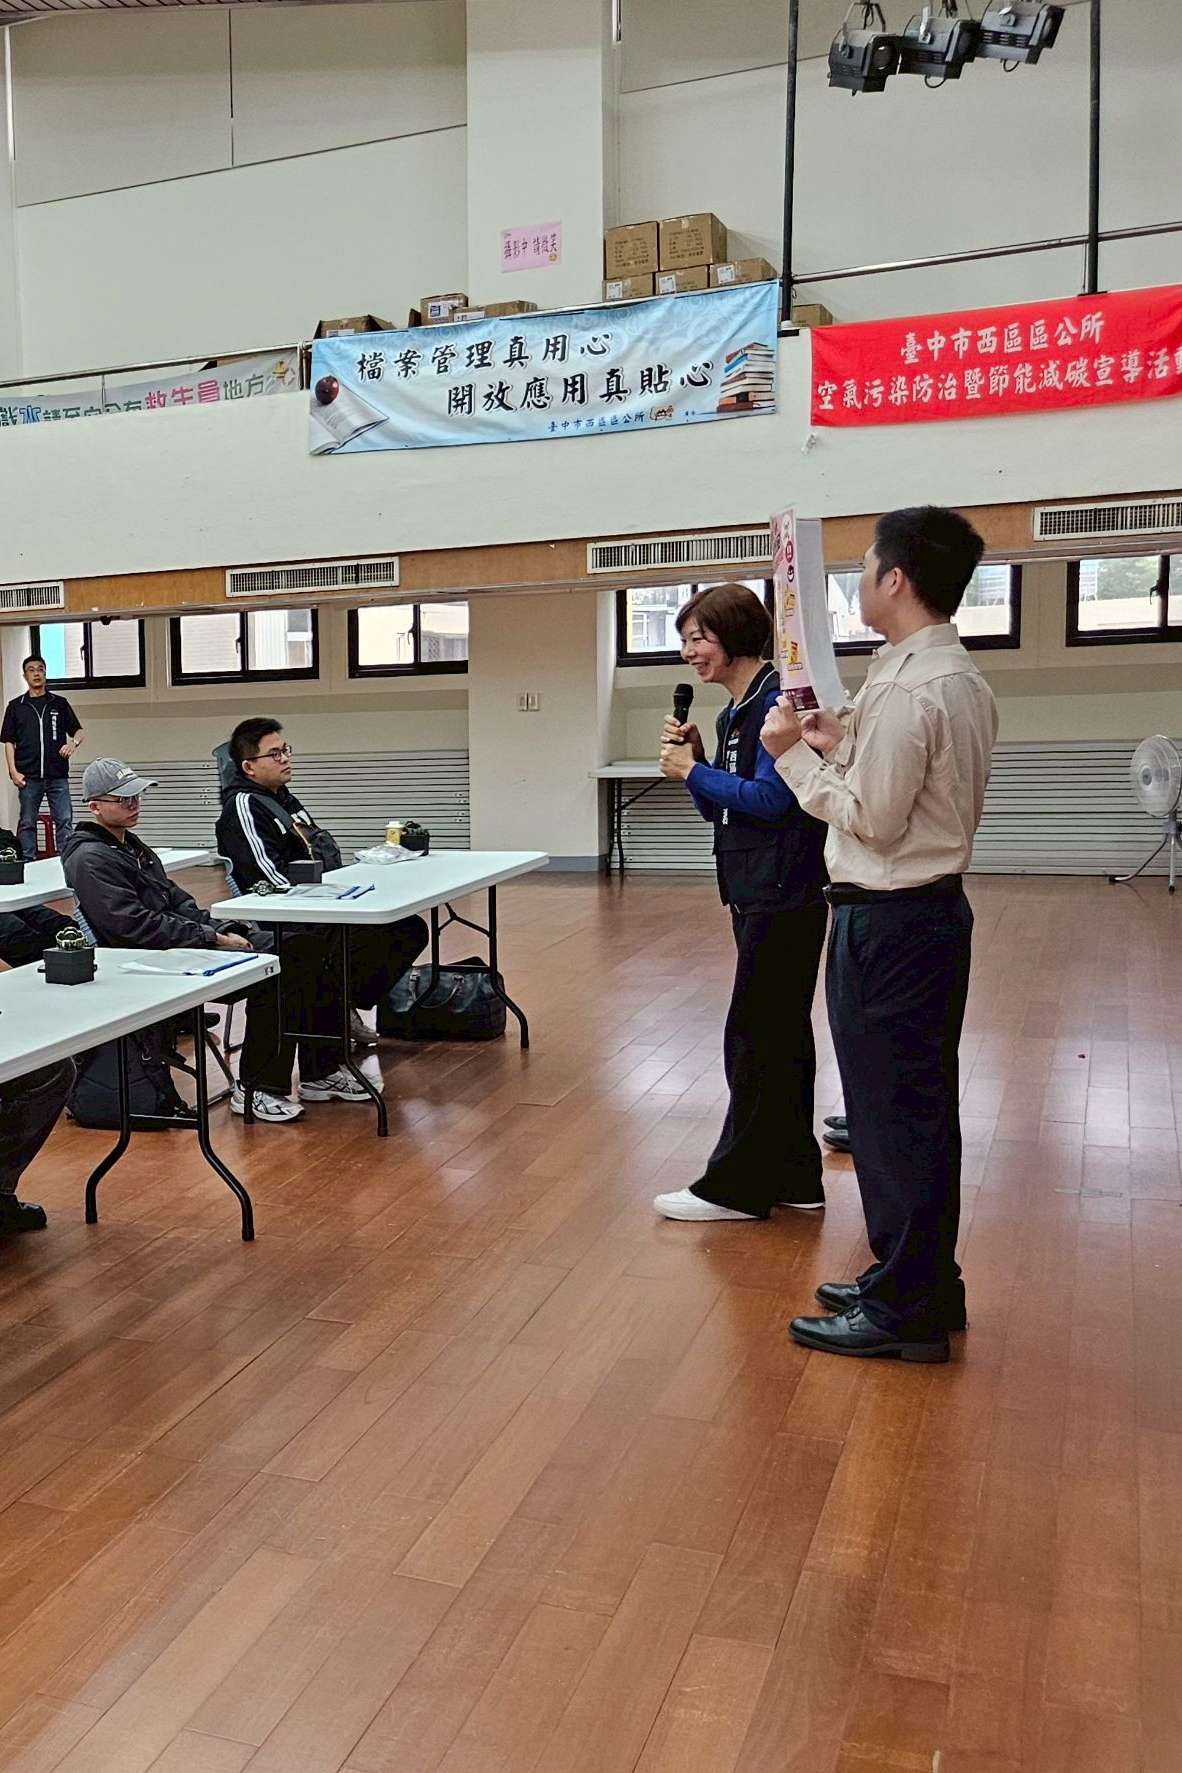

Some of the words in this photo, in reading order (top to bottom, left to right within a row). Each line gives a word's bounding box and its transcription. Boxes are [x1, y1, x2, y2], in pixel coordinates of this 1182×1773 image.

[357, 332, 614, 382] 檔案管理真用心
[899, 311, 1105, 365] 臺中市西區區公所
[446, 359, 717, 416] 開放應用真貼心
[548, 411, 646, 432] 臺中市西區區公所
